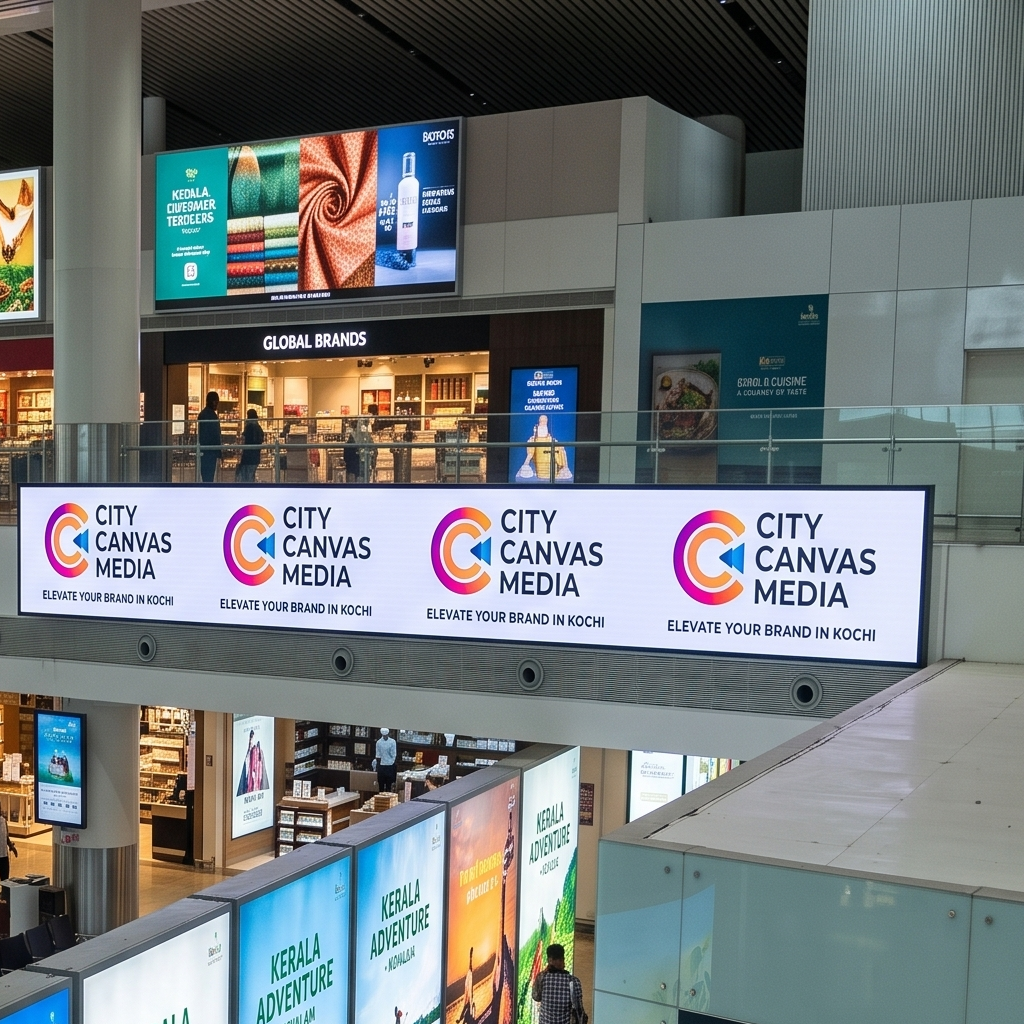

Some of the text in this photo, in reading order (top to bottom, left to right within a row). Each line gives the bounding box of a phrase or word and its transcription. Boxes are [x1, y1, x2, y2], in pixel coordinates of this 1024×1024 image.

[263, 331, 367, 350] GLOBAL BRANDS
[95, 505, 137, 526] CITY
[283, 506, 331, 530] CITY
[500, 508, 557, 534] CITY
[757, 512, 823, 540] CITY
[95, 531, 172, 554] CANVAS
[283, 535, 371, 560] CANVAS
[499, 540, 604, 567] CANVAS
[95, 557, 156, 580] MEDIA
[755, 545, 877, 575] CANVAS
[283, 563, 352, 588] MEDIA
[499, 571, 580, 598] MEDIA
[42, 589, 174, 606] ELEVATE YOUR BRAND IN KOCHI
[754, 577, 849, 608] MEDIA
[220, 598, 372, 617] ELEVATE YOUR BRAND IN KOCHI
[426, 607, 605, 628] ELEVATE YOUR BRAND IN KOCHI
[667, 619, 876, 642] ELEVATE YOUR BRAND IN KOCHI
[536, 801, 564, 835] KERALA
[528, 823, 571, 865] ADVENTURE
[381, 878, 421, 922] KERALA
[369, 903, 430, 960] ADVENTURE
[270, 932, 321, 985] KERALA
